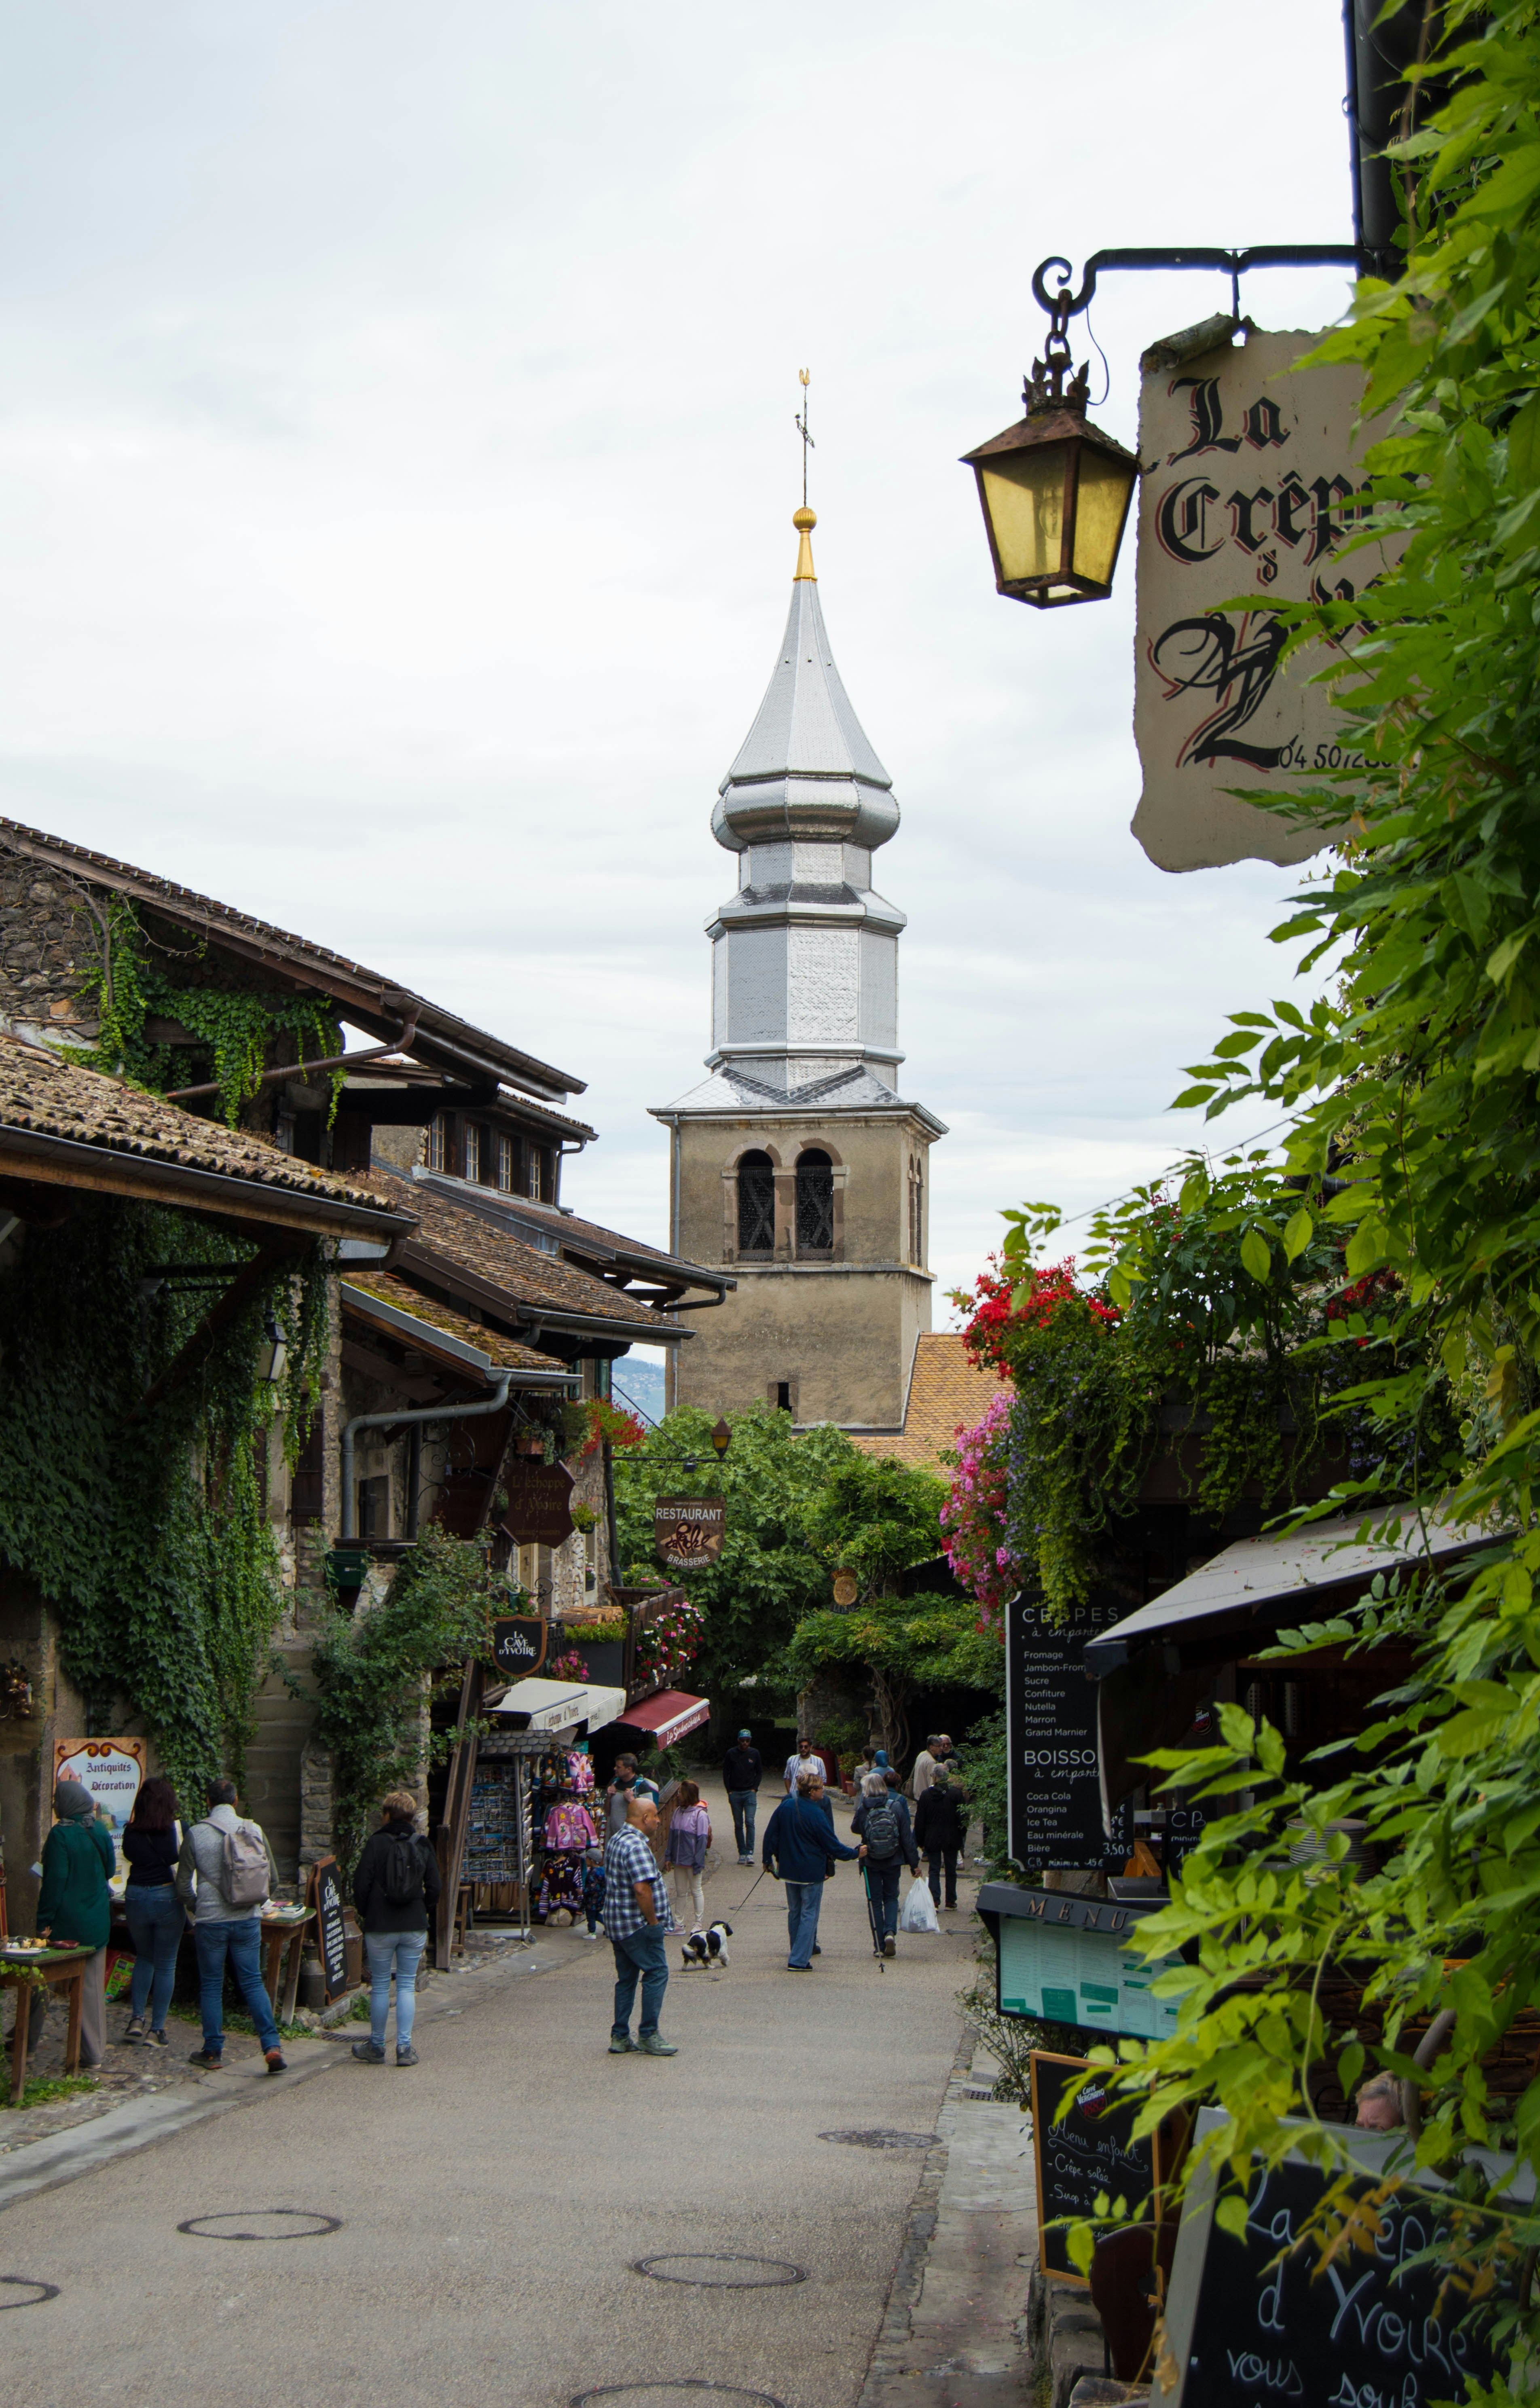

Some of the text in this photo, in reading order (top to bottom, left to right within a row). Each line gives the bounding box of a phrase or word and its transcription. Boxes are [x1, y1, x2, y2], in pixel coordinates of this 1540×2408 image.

[1167, 377, 1290, 466] La
[656, 1508, 722, 1521] RESTAURANT
[667, 1554, 711, 1566] BRASSERIE
[1024, 1651, 1063, 1660] Fromage
[1025, 1690, 1066, 1698] Confiture
[1025, 1703, 1056, 1711] Nutella
[1026, 1716, 1056, 1724] Marron
[1026, 1728, 1087, 1737] Grand Marnier
[86, 1762, 131, 1775] Antiquités
[91, 1781, 135, 1791] Décoration
[1051, 1792, 1071, 1800] Cola
[1026, 1805, 1067, 1814] Orangina
[1172, 1811, 1206, 1828] CB
[1047, 1831, 1084, 1839] minérale
[1028, 1844, 1050, 1852] Bière
[1026, 1896, 1129, 1930] MENU
[1084, 2097, 1105, 2116] 1882
[1048, 2116, 1142, 2166] Menu enfant
[1055, 2153, 1112, 2184] Crêpe salée
[1227, 2349, 1303, 2395] vous
